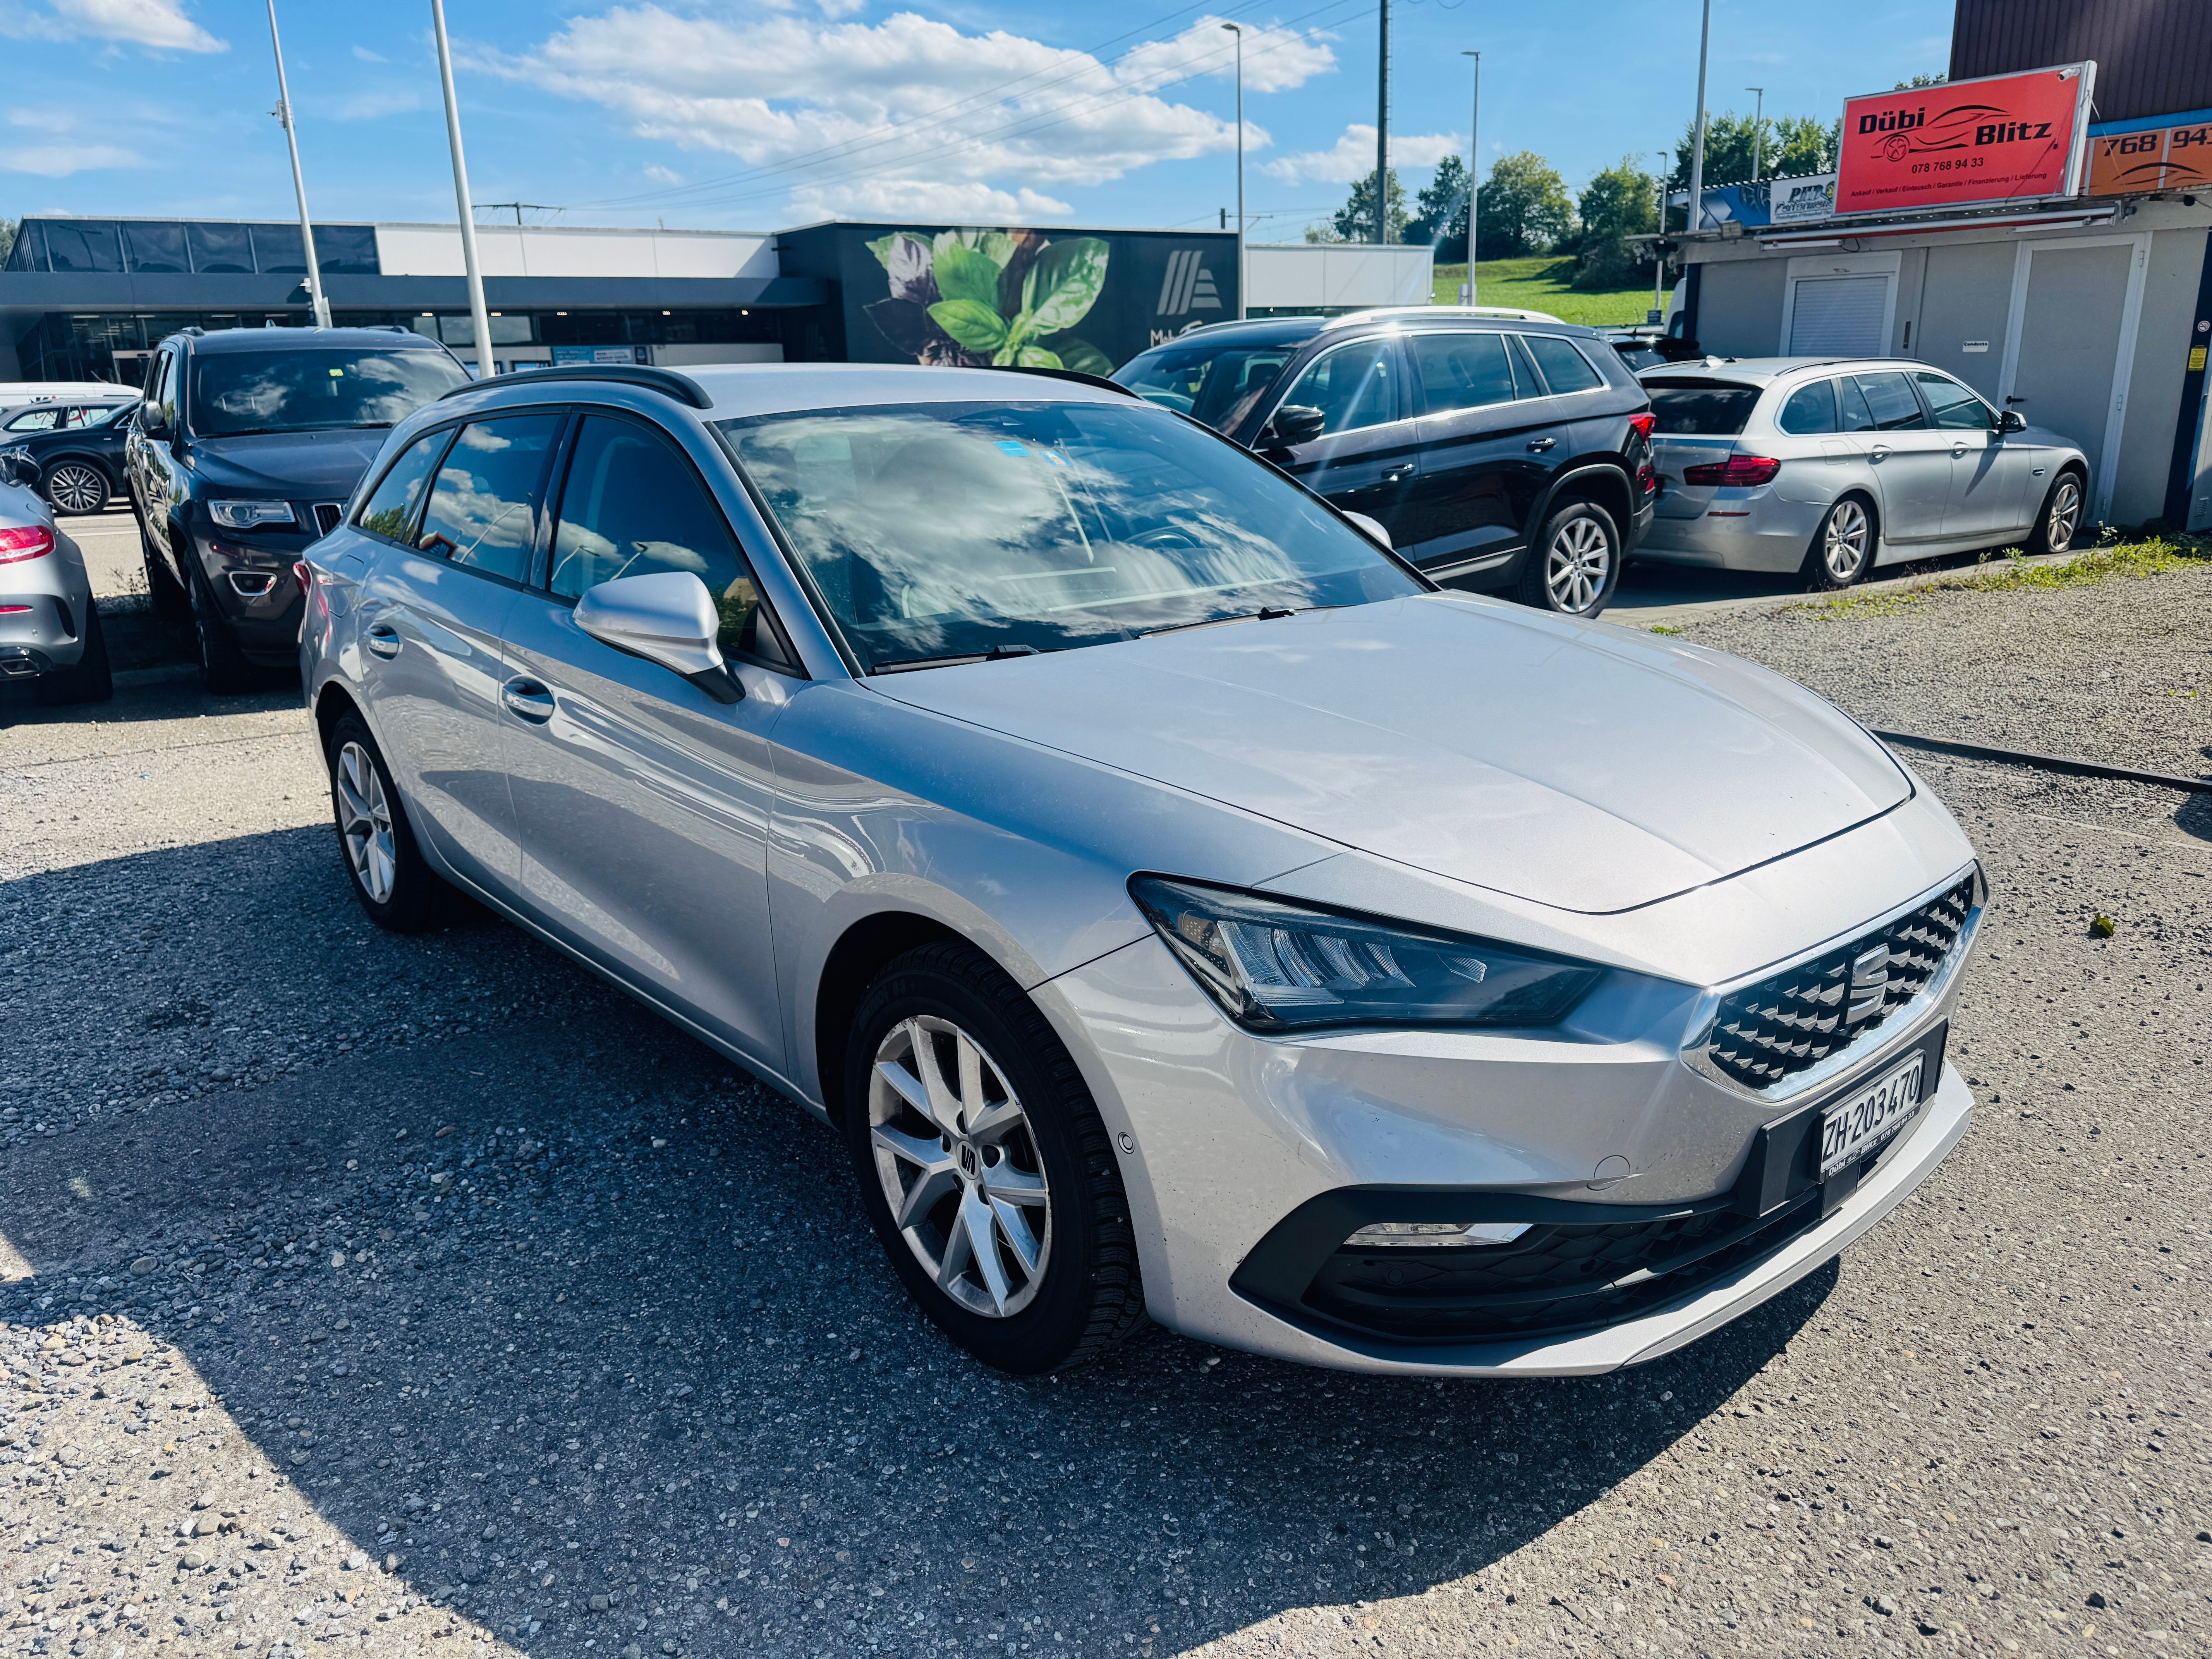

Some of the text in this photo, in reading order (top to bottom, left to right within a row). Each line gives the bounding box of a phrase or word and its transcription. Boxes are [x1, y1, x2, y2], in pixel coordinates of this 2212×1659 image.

[1859, 108, 1925, 134] Dübi
[1975, 122, 2052, 146] Blitz
[2103, 134, 2157, 156] 768
[1911, 157, 1984, 173] 078 768 94 33
[1937, 180, 1963, 188] Garantie
[1968, 176, 2009, 185] Finanzierung
[2015, 173, 2047, 181] Lieferung
[1829, 1110, 1915, 1176] Dübi Blitz 078 768 94 33
